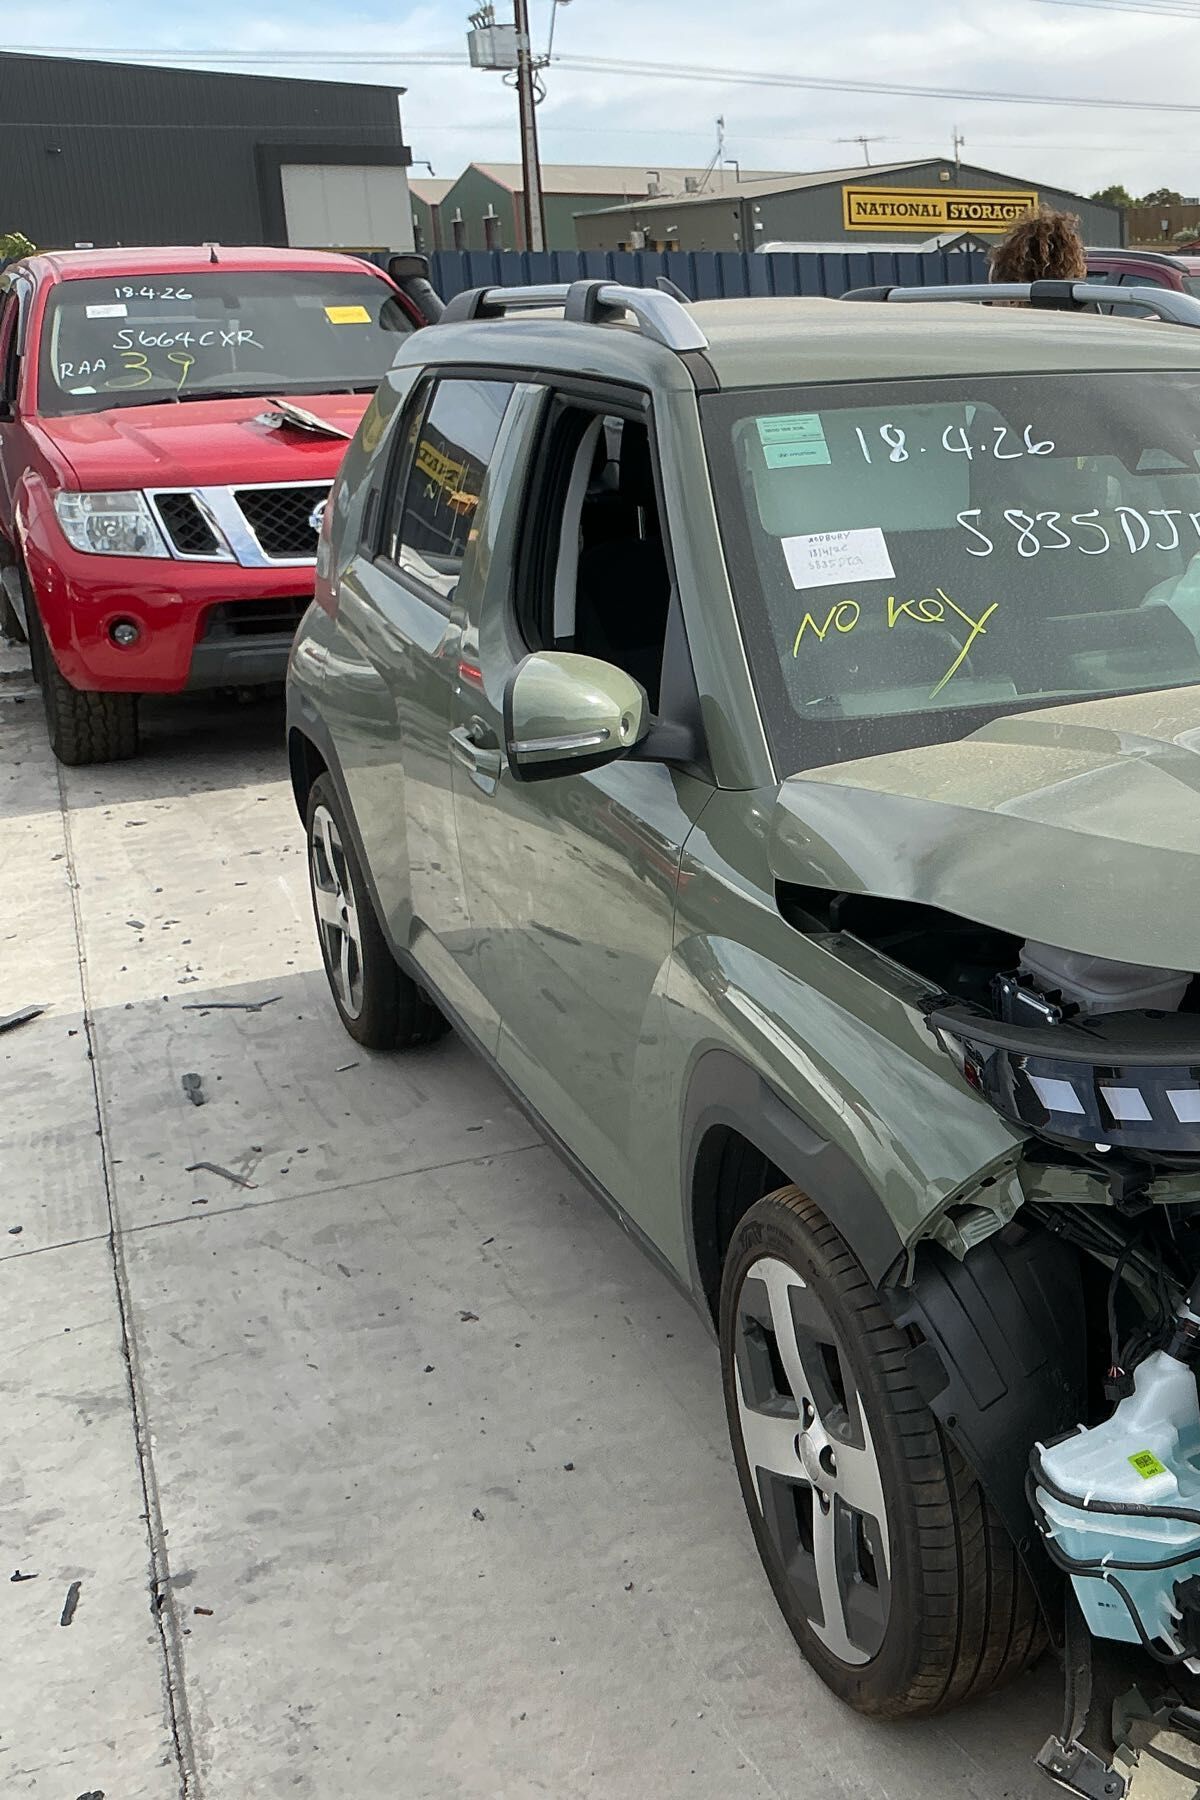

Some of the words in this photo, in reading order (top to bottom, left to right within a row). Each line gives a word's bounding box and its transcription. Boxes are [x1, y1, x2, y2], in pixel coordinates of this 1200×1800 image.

[856, 202, 942, 217] NATIONAL
[115, 286, 193, 300] 18.4.26
[112, 329, 264, 350] S664CXR
[60, 358, 106, 379] RAA
[105, 352, 195, 392] 39
[793, 599, 860, 658] NO
